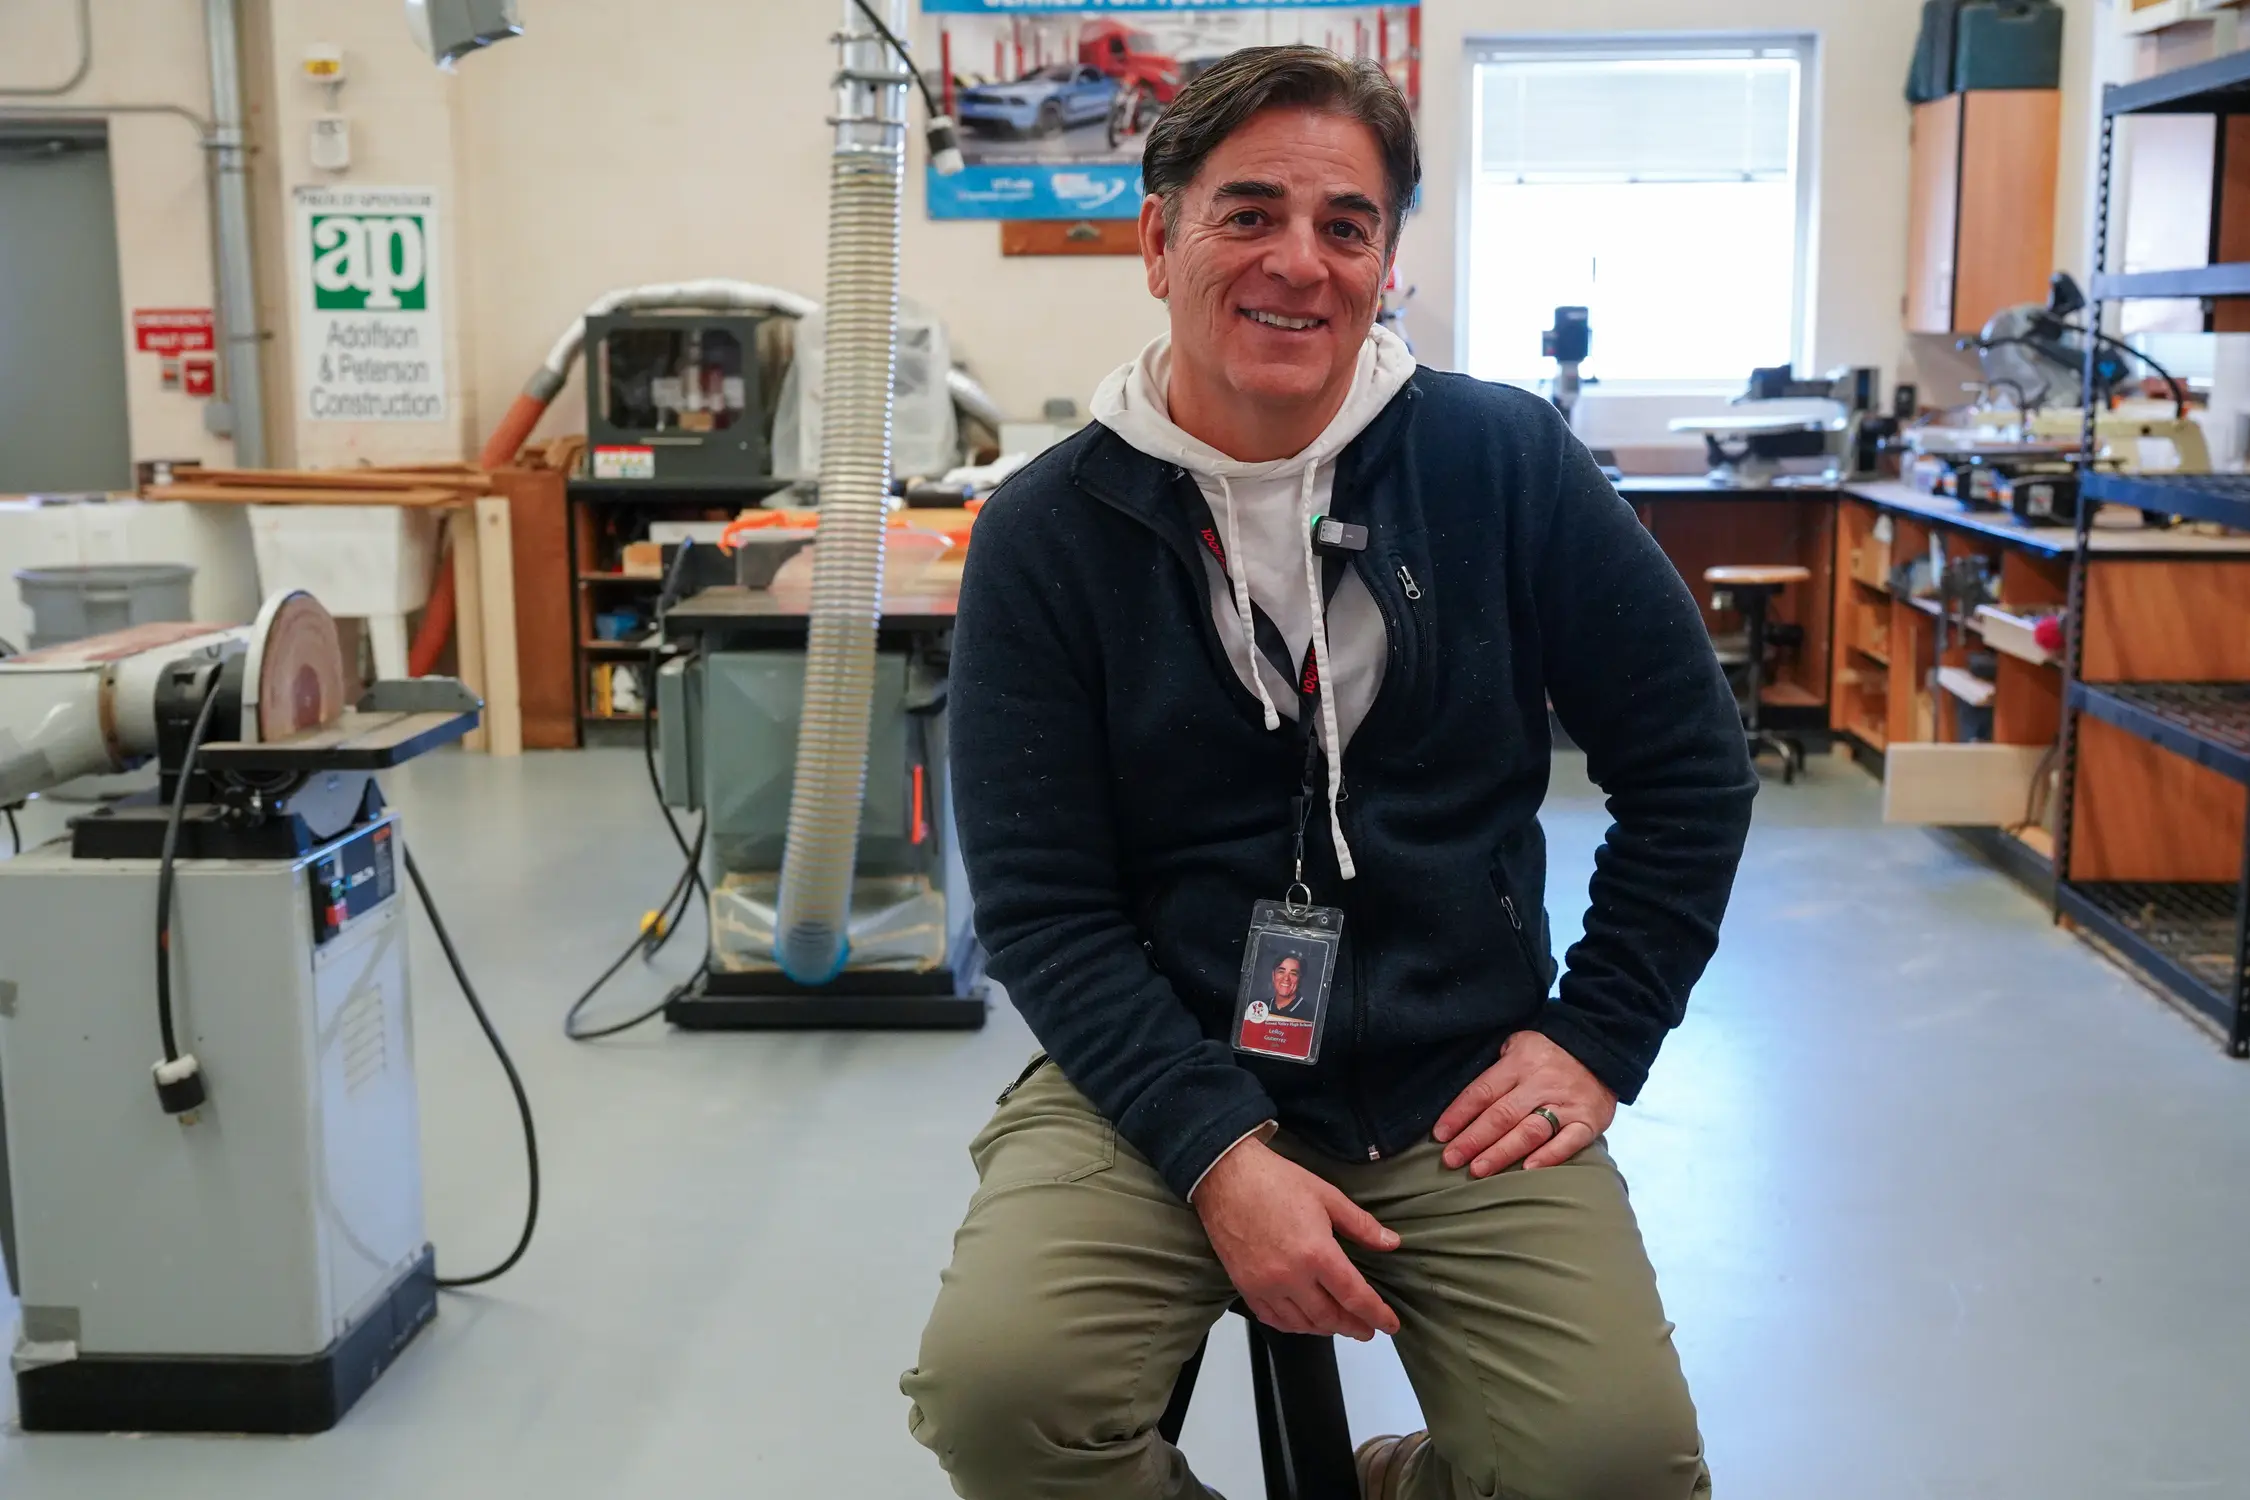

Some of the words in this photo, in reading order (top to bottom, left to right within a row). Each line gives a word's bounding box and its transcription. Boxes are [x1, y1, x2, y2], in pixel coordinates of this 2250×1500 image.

[313, 216, 425, 311] ap
[327, 320, 419, 347] Adolfson
[318, 353, 334, 383] &
[338, 353, 430, 382] Peterson
[309, 386, 442, 417] Construction
